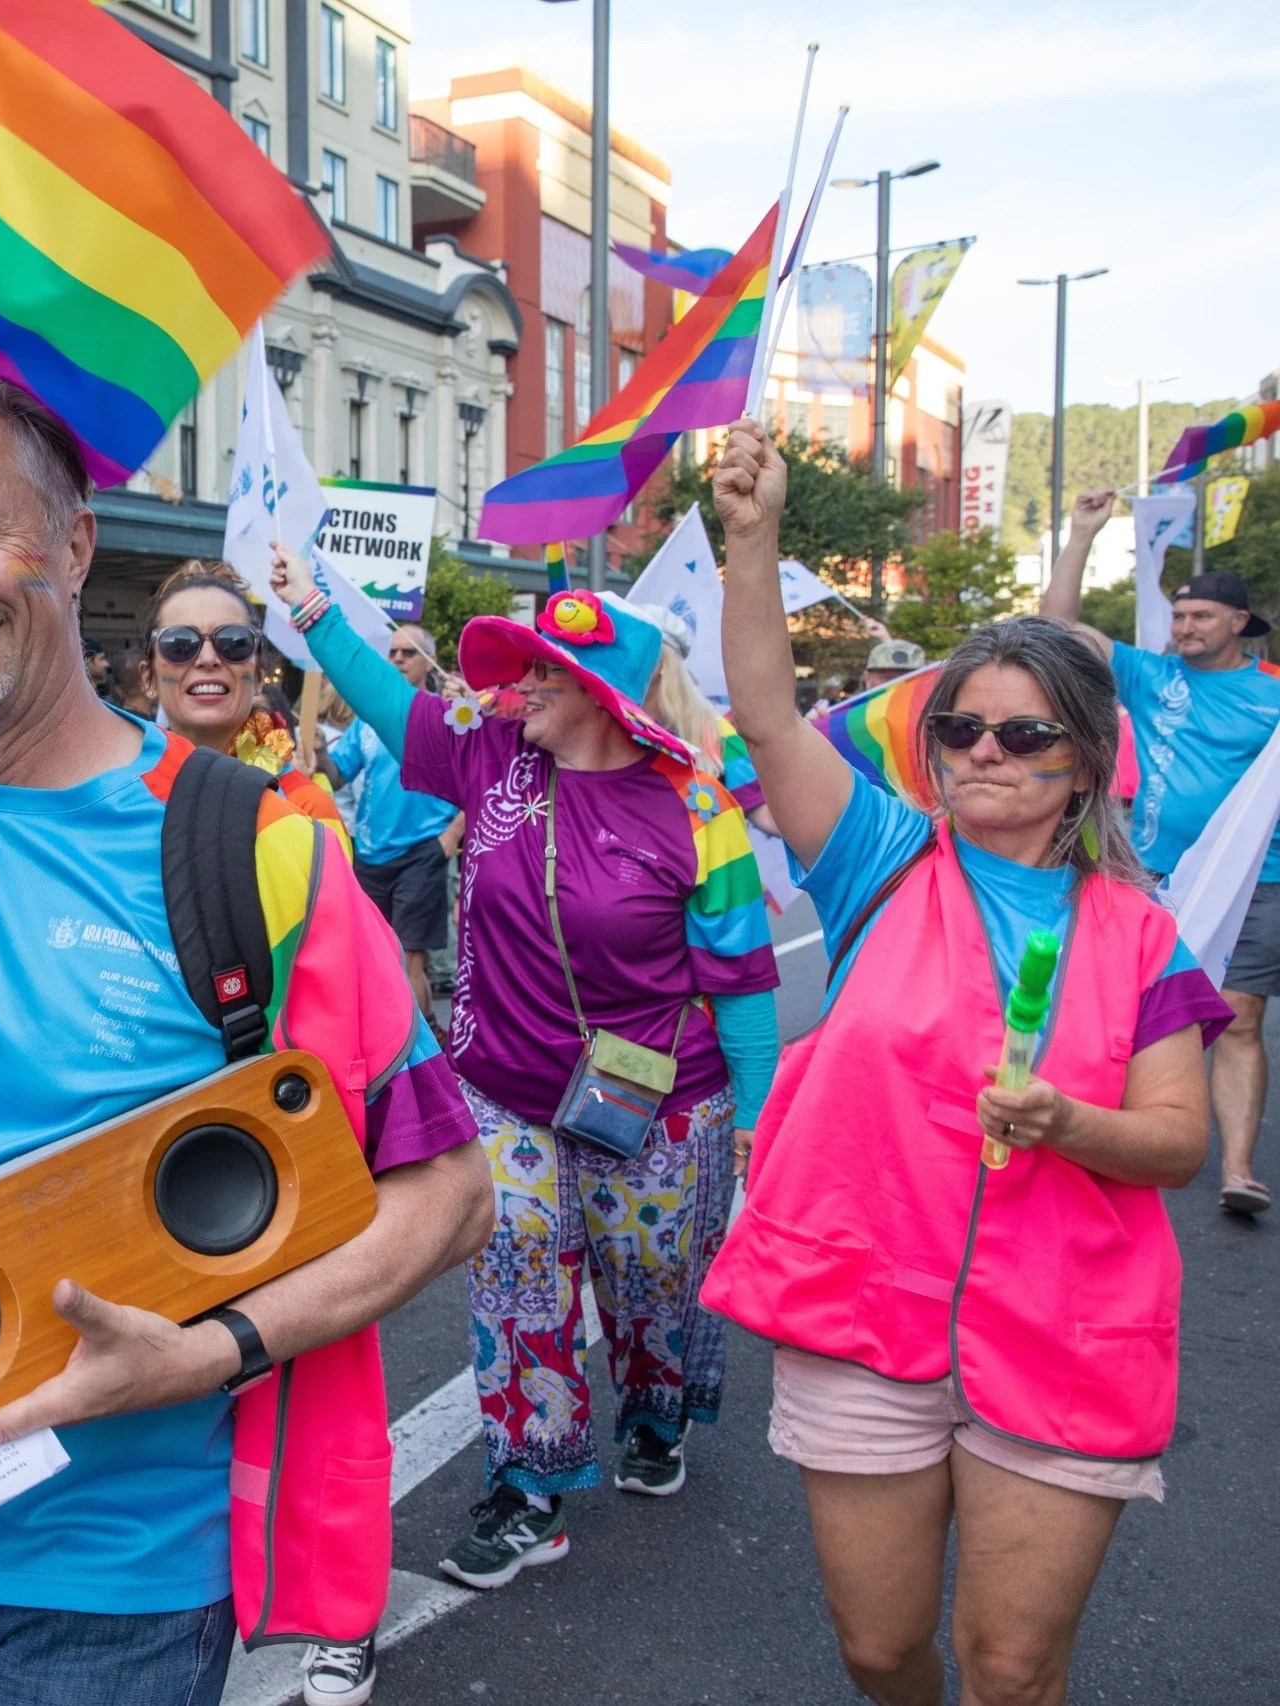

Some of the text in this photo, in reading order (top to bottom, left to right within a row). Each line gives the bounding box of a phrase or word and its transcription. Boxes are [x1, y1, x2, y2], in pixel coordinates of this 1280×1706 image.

[328, 507, 398, 534] CTIONS
[330, 534, 423, 562] NETWORK
[82, 924, 101, 943] ARA
[100, 970, 160, 992] OUR VALUES
